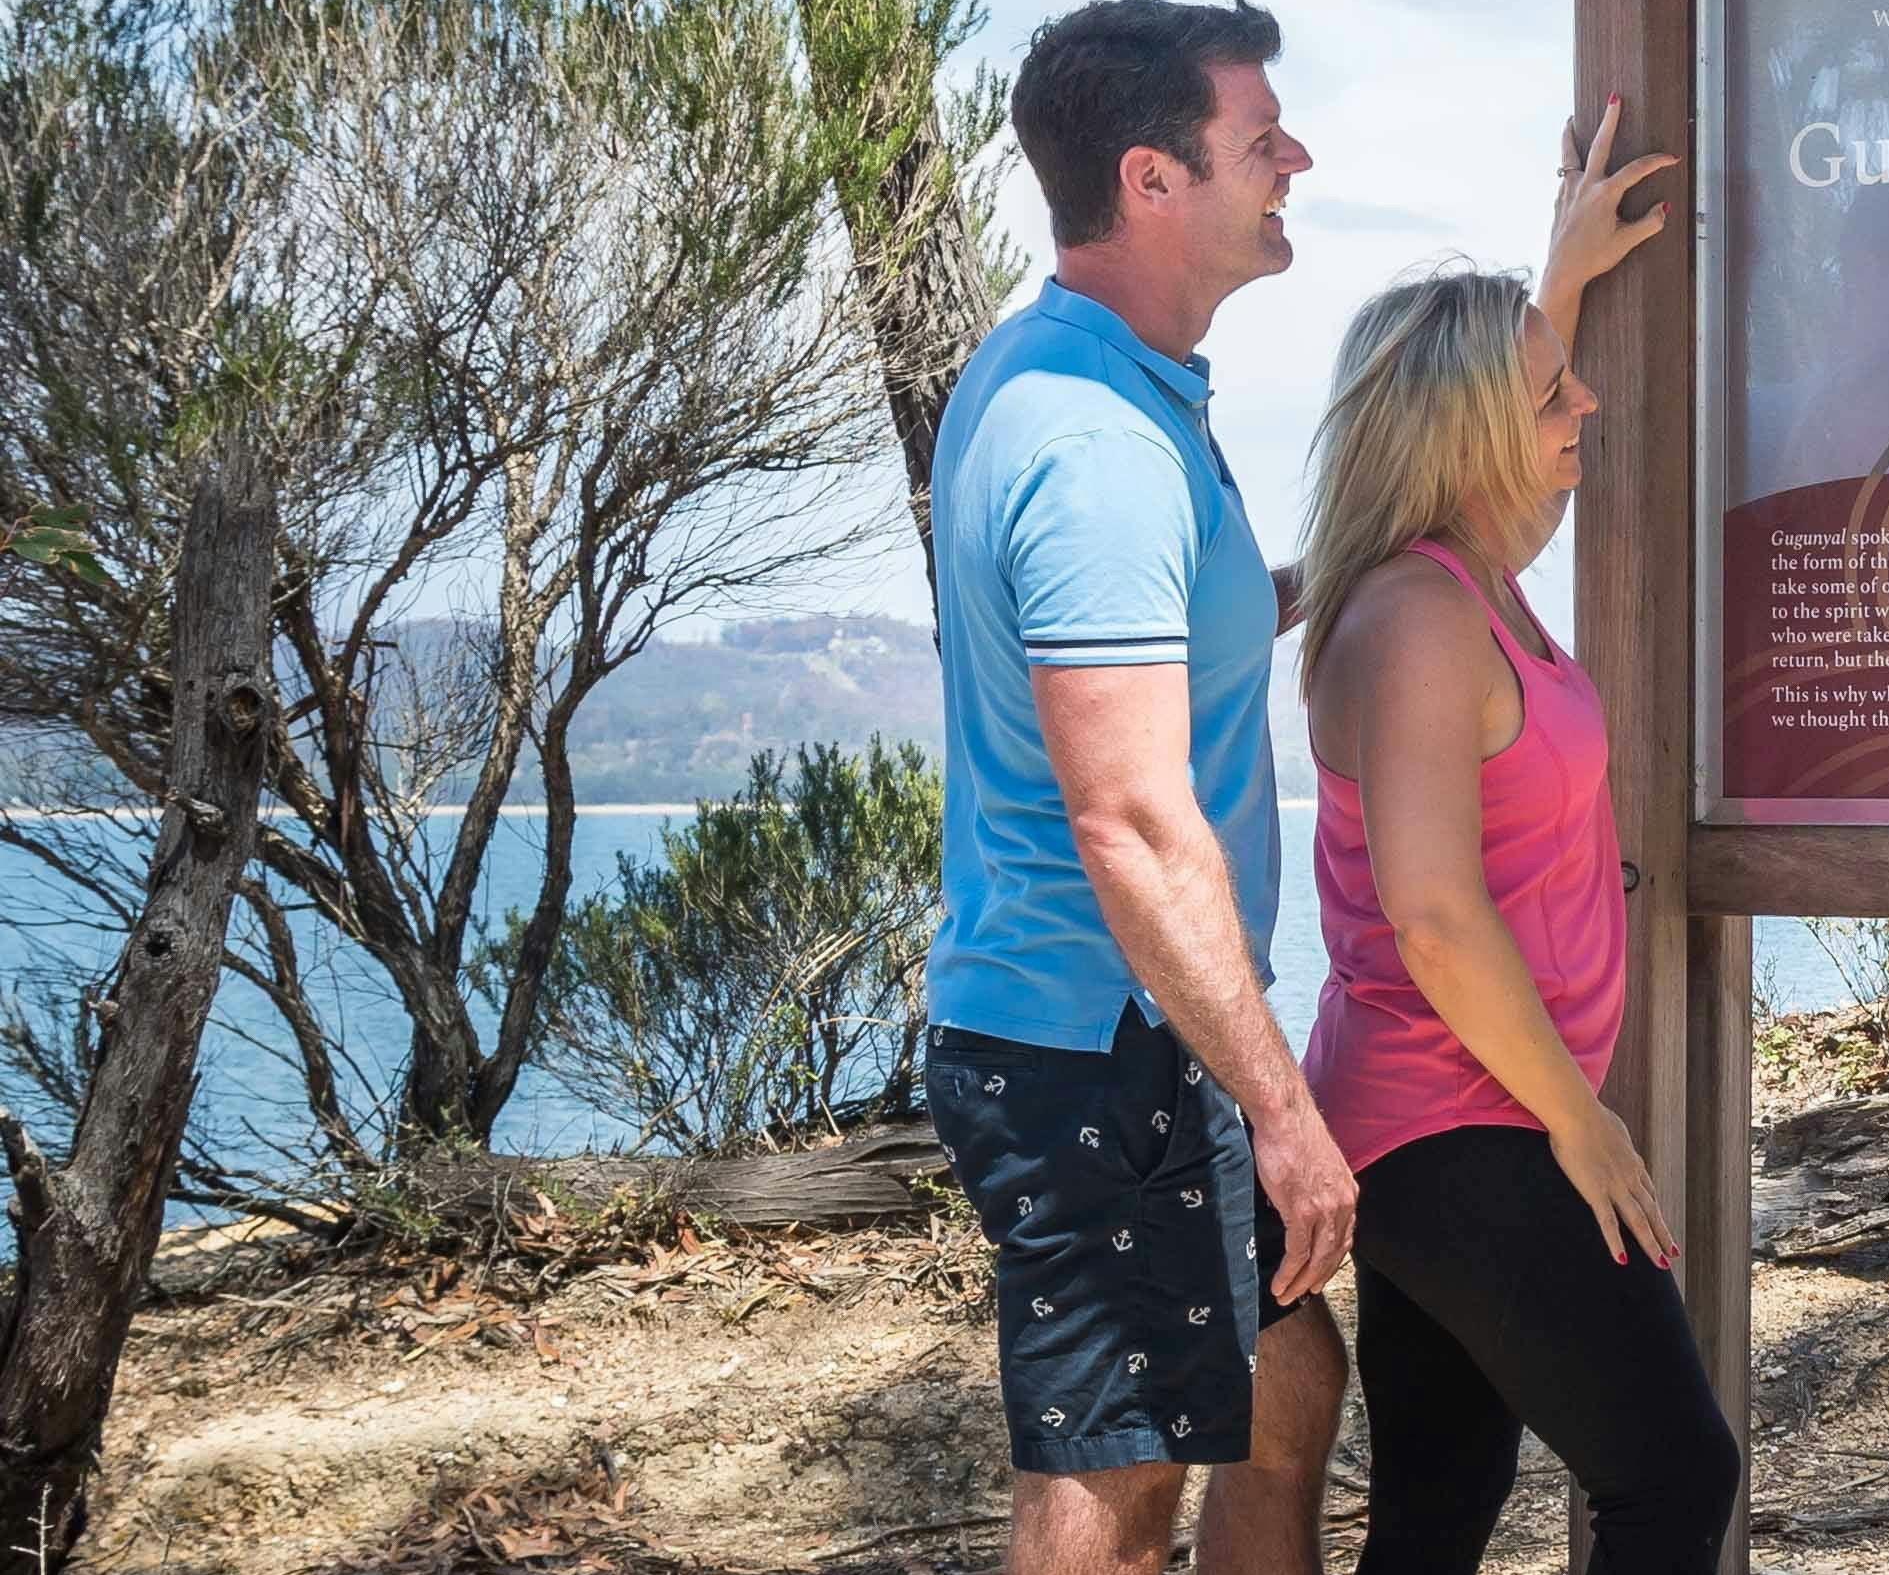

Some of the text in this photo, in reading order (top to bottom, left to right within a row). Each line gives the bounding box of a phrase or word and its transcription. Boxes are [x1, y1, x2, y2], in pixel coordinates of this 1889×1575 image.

[1771, 528, 1846, 551] Gugunyal
[1771, 553, 1798, 571] the
[1802, 553, 1843, 570] form
[1848, 552, 1867, 569] of
[1771, 625, 1806, 643] who
[1811, 630, 1852, 643] were
[1772, 653, 1830, 670] return,
[1834, 650, 1862, 667] but
[1771, 685, 1810, 703] This
[1814, 686, 1828, 703] is
[1833, 685, 1868, 707] why
[1771, 714, 1795, 727] we
[1800, 709, 1866, 731] thought
